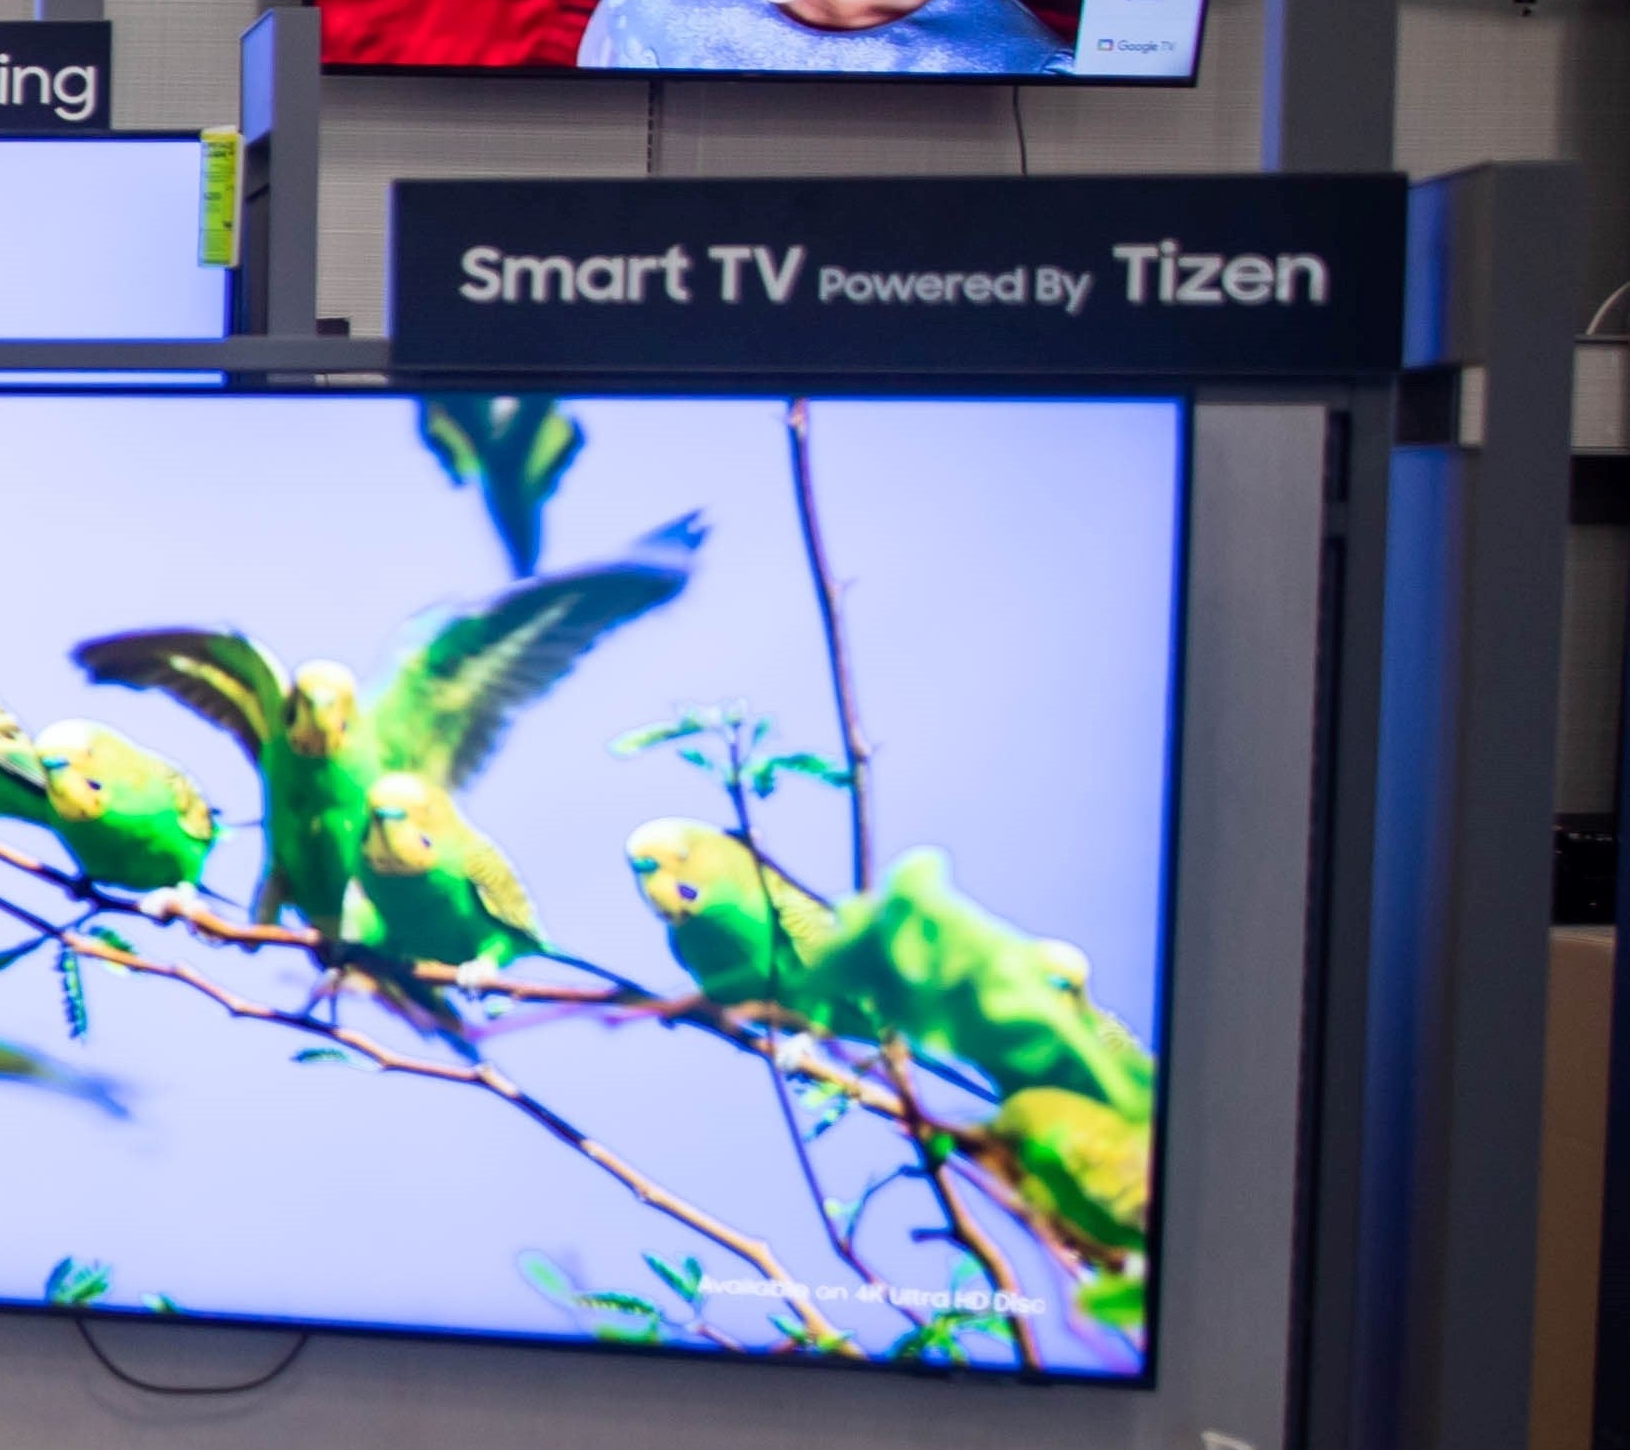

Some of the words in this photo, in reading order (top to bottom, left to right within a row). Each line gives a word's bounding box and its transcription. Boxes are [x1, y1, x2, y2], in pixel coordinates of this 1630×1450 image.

[1116, 39, 1158, 53] Google
[458, 245, 691, 304] Smart
[707, 245, 805, 304] TV
[818, 267, 1025, 305] Powered
[1034, 268, 1092, 315] By
[1113, 240, 1326, 305] Tizen
[699, 1275, 810, 1301] Available
[815, 1283, 849, 1301] on
[855, 1283, 886, 1304] 4K
[891, 1285, 948, 1309] Ultra
[954, 1289, 989, 1311] HD
[993, 1292, 1046, 1315] Disc
